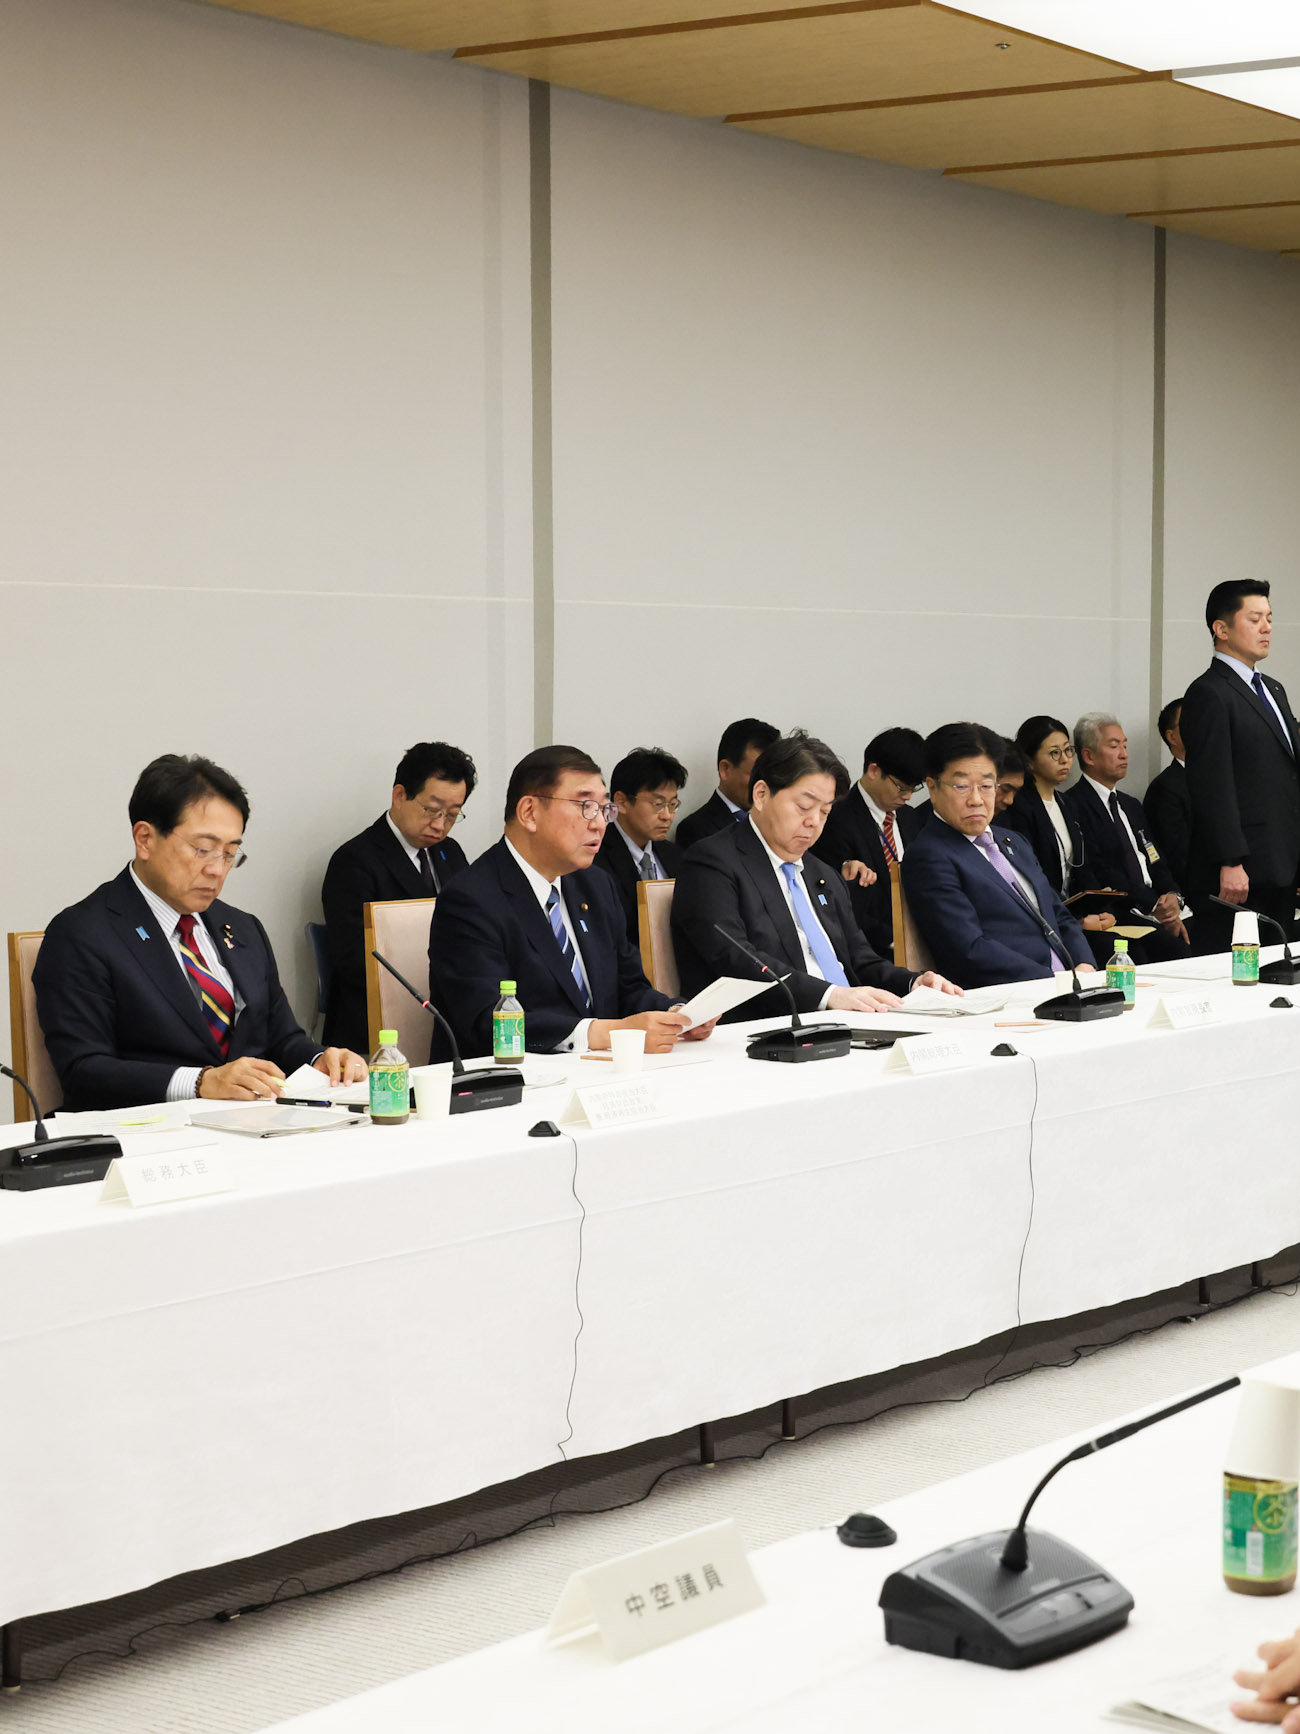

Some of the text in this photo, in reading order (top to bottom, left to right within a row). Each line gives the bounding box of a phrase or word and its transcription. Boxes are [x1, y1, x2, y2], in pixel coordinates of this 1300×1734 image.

[394, 1072, 405, 1089] 茶
[139, 1159, 209, 1183] 総務大臣
[1263, 1496, 1287, 1527] 茶
[624, 1563, 724, 1617] 中空議員
